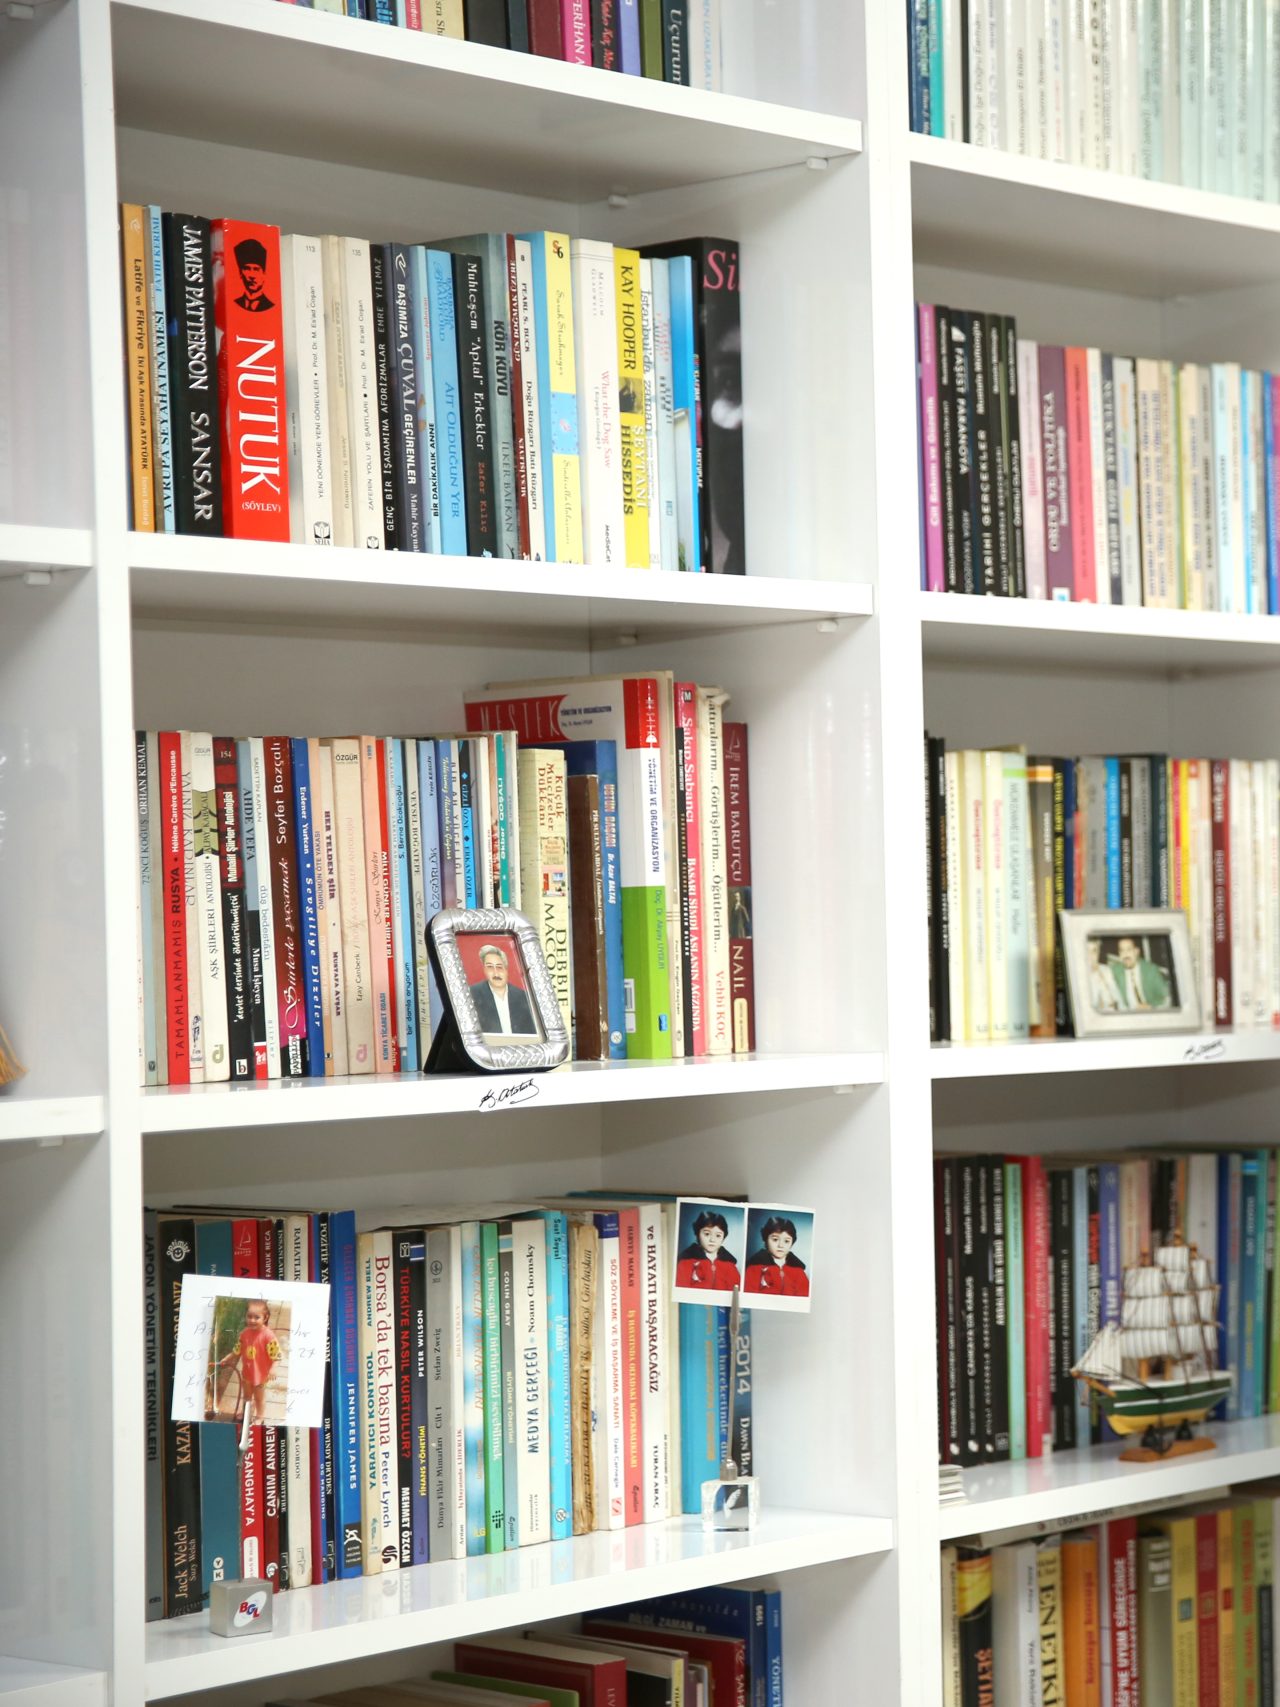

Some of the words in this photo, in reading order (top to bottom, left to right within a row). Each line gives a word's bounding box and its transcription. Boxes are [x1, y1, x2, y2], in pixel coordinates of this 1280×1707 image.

[134, 259, 143, 292] Latife
[183, 225, 204, 283] JAMES
[375, 257, 383, 298] YILMAZ
[509, 260, 517, 292] ÜZERE
[621, 265, 633, 298] KAY
[136, 310, 144, 349] Fikriye
[396, 284, 408, 338] BAŞIMIZA
[510, 294, 519, 339] DOĞMAK
[185, 286, 209, 390] PATTERSON
[467, 262, 478, 329] Muhteşem
[473, 392, 486, 450] Erkekler
[494, 320, 506, 351] KÖR
[513, 342, 521, 362] GÜN
[622, 303, 636, 370] HOOPER
[378, 343, 389, 413] AFORİZMALAR
[397, 343, 416, 410] ÇUVAL
[495, 355, 509, 396] KUYU
[236, 335, 281, 494] NUTUK
[428, 423, 436, 448] ANNE
[956, 398, 969, 475] PARANOYA
[140, 428, 148, 470] ATATÜRK
[190, 412, 213, 521] SANSAR
[403, 414, 417, 485] GEÇİRENLER
[162, 451, 172, 512] AVRUPA
[384, 481, 393, 500] BİR
[429, 451, 439, 500] DAKİKALIK
[242, 500, 281, 513] (SÖYLEV)
[386, 506, 395, 531] GENÇ
[430, 503, 439, 517] BİR
[451, 492, 460, 518] YER
[503, 482, 514, 532] BALKAN
[1047, 505, 1060, 553] ORDU
[137, 741, 147, 782] KEMAL
[682, 717, 694, 761] Sakıp
[169, 750, 177, 797] d'Encausse
[270, 742, 284, 793] Bozçalı
[138, 785, 148, 815] ORHAN
[181, 771, 192, 820] YALNIZ
[223, 791, 235, 825] Antolojisi
[538, 767, 546, 827] Dükkanı
[546, 763, 555, 830] Mucizeler
[555, 775, 564, 817] Küçük
[684, 764, 694, 823] Sabancı
[224, 826, 236, 853] Şiirler
[275, 799, 287, 844] Seyfet
[650, 810, 660, 873] ORGANİZASYON
[183, 828, 196, 906] KADINLAR
[225, 854, 238, 882] Muhalif
[245, 830, 255, 861] VEFA
[730, 811, 743, 882] BARUTÇU
[171, 867, 182, 914] RUSYA
[278, 857, 295, 933] yaşamak
[430, 847, 440, 910] ÖZGÜRLÜK
[299, 787, 307, 819] Erdener
[305, 877, 316, 956] Sevgiliye
[311, 965, 320, 1027] Dizeler
[209, 958, 218, 979] AŞK
[233, 957, 243, 993] dersinde
[252, 948, 260, 972] Musa
[556, 929, 569, 1007] DEBBIE
[689, 933, 700, 981] ASLANIN
[732, 945, 745, 993] NAİL
[171, 920, 184, 1059] TAMAMLANMAMIŞ
[253, 974, 263, 1004] İşleyen
[715, 970, 725, 1008] Vehbi
[715, 1011, 726, 1040] KOÇ
[166, 1238, 191, 1256] optimist
[320, 1222, 328, 1263] POZİTİF
[647, 1226, 655, 1240] ve
[145, 1236, 155, 1287] JAPON
[526, 1244, 535, 1297] Chomsky
[647, 1244, 657, 1296] HAYATI
[375, 1256, 392, 1344] Borsa'da
[400, 1267, 411, 1328] TÜRKİYE
[486, 1277, 498, 1329] buscaglia
[146, 1292, 156, 1368] YÖNETİM
[400, 1333, 411, 1372] NASIL
[434, 1328, 442, 1354] Zweig
[646, 1299, 660, 1394] BAŞARACAĞIZ
[366, 1351, 376, 1418] KONTROL
[377, 1349, 393, 1376] tek
[434, 1356, 442, 1381] Stefan
[488, 1336, 501, 1396] birbirimizi
[524, 1346, 541, 1402] GERÇEĞİ
[736, 1337, 751, 1395] 2014
[146, 1372, 157, 1461] TEKNİKLERİ
[347, 1383, 356, 1445] JENNIFER
[400, 1375, 413, 1459] KURTULUR?
[490, 1399, 502, 1460] sevebilmek
[527, 1407, 540, 1454] MEDYA
[740, 1417, 750, 1451] DAWN
[266, 1425, 277, 1478] ANNEM
[348, 1450, 357, 1490] JAMES
[367, 1423, 377, 1489] YARATICI
[381, 1451, 389, 1486] Peter
[266, 1481, 277, 1517] CANIM
[418, 1468, 427, 1496] FİNANS
[380, 1490, 393, 1528] Lynch
[401, 1487, 411, 1527] MEHMET
[174, 1525, 188, 1564] Welch
[401, 1528, 412, 1563] ÖZCAN
[175, 1567, 189, 1599] Jack
[1113, 1557, 1127, 1628] SÜRECİNDE
[239, 1602, 260, 1619] BGL
[1039, 1585, 1056, 1629] EN
[1115, 1632, 1128, 1670] UYUM
